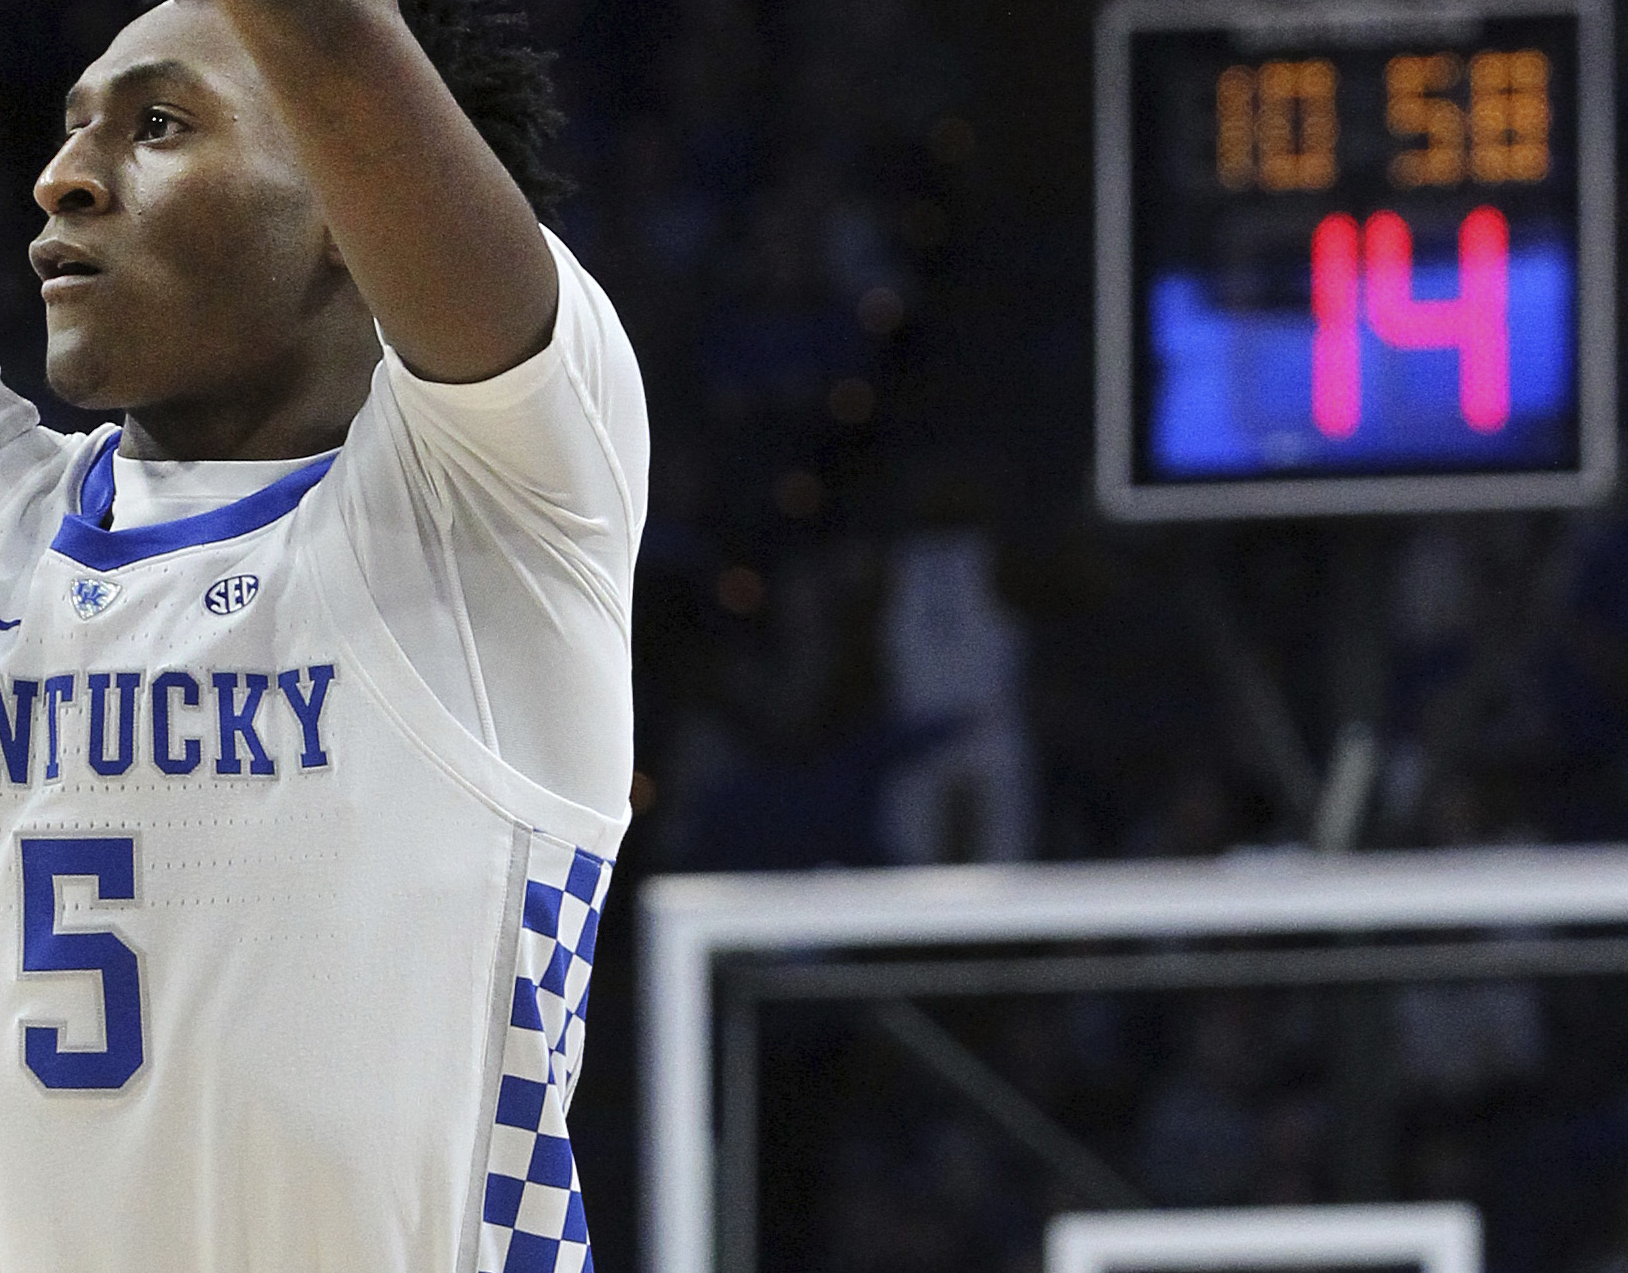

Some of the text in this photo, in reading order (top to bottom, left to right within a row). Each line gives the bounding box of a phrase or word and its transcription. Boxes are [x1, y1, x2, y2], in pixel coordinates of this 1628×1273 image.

[1216, 50, 1551, 190] 10 58
[1311, 205, 1510, 439] 14
[206, 575, 258, 615] SEC
[15, 831, 145, 1095] 5
